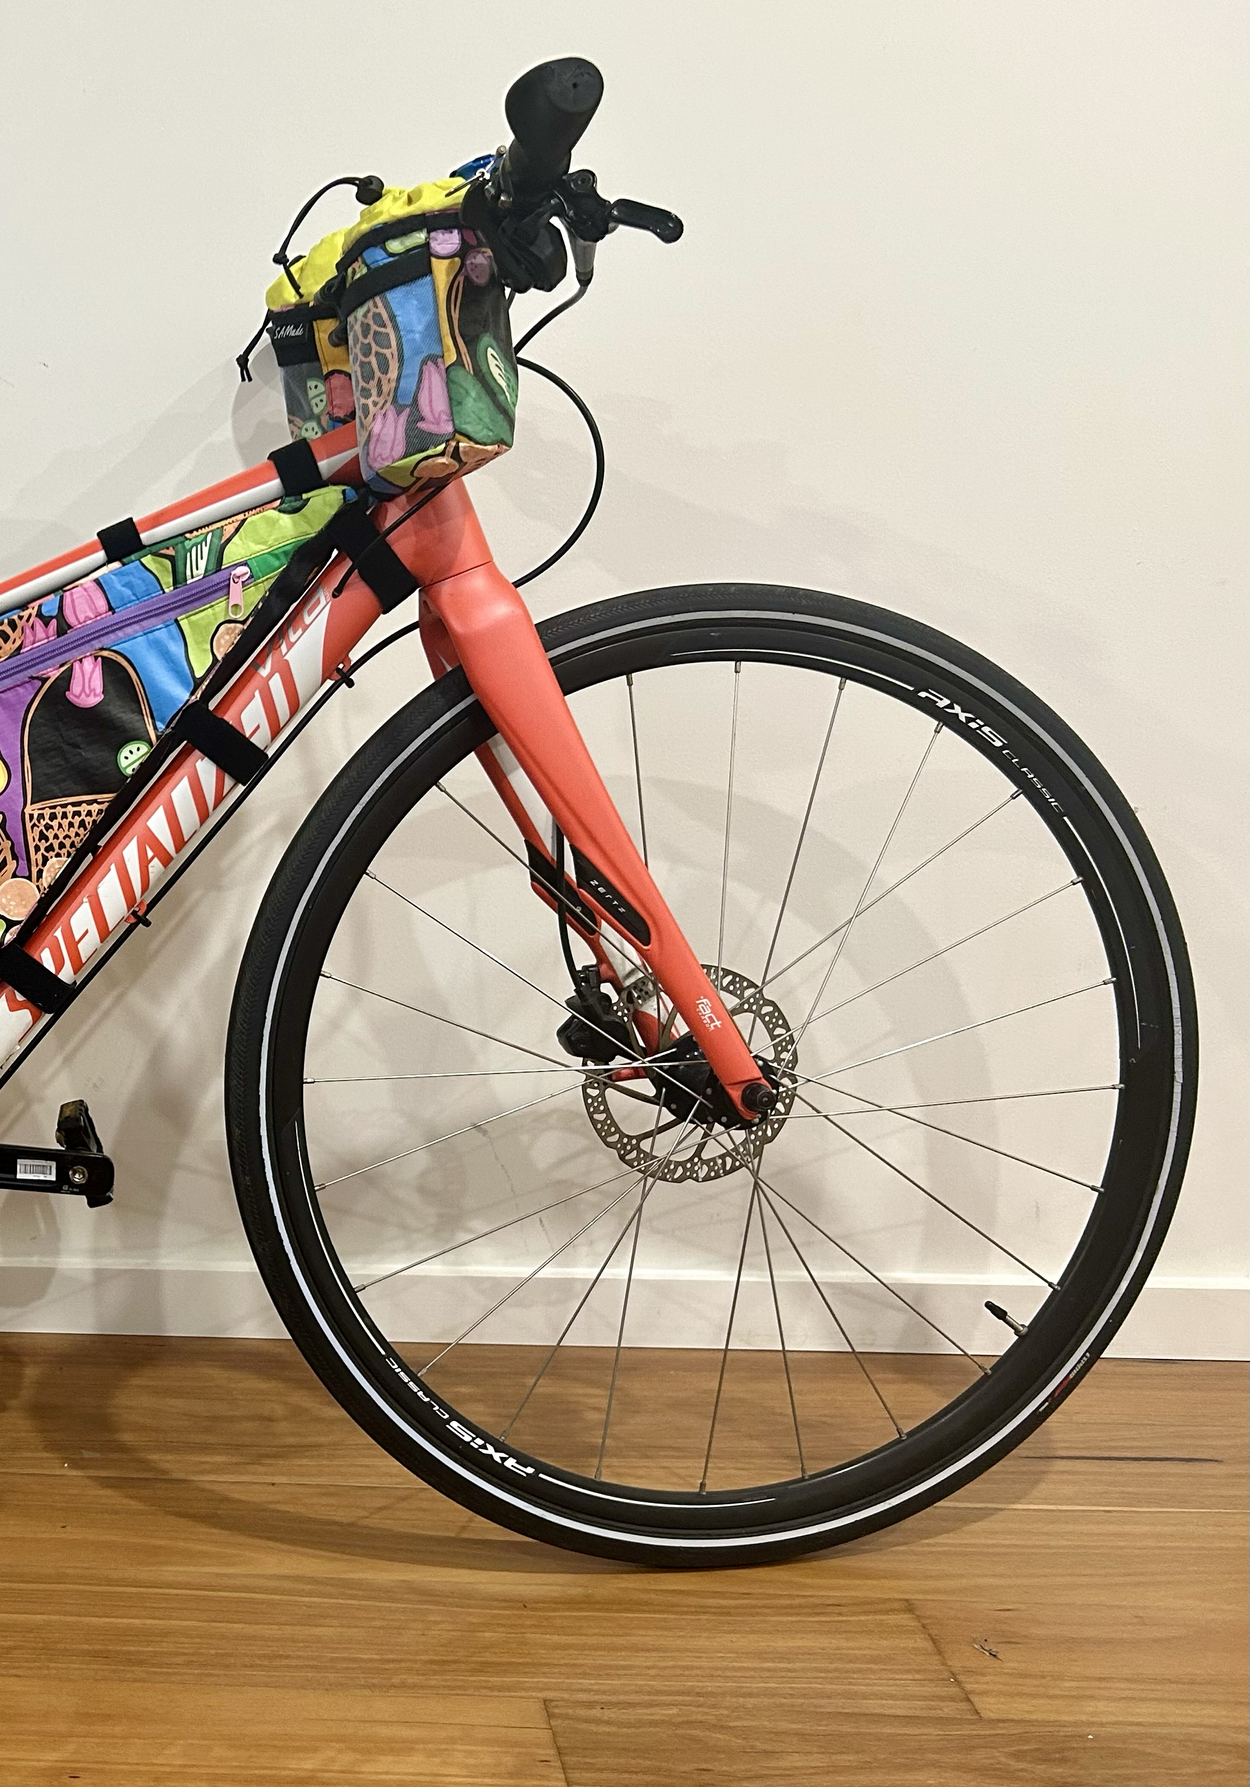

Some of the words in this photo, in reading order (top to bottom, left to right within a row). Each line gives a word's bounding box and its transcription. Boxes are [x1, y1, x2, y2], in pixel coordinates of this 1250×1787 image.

[273, 322, 305, 340] SAMade
[1002, 749, 1066, 813] CLASSIC
[385, 1357, 450, 1420] CLASSIC
